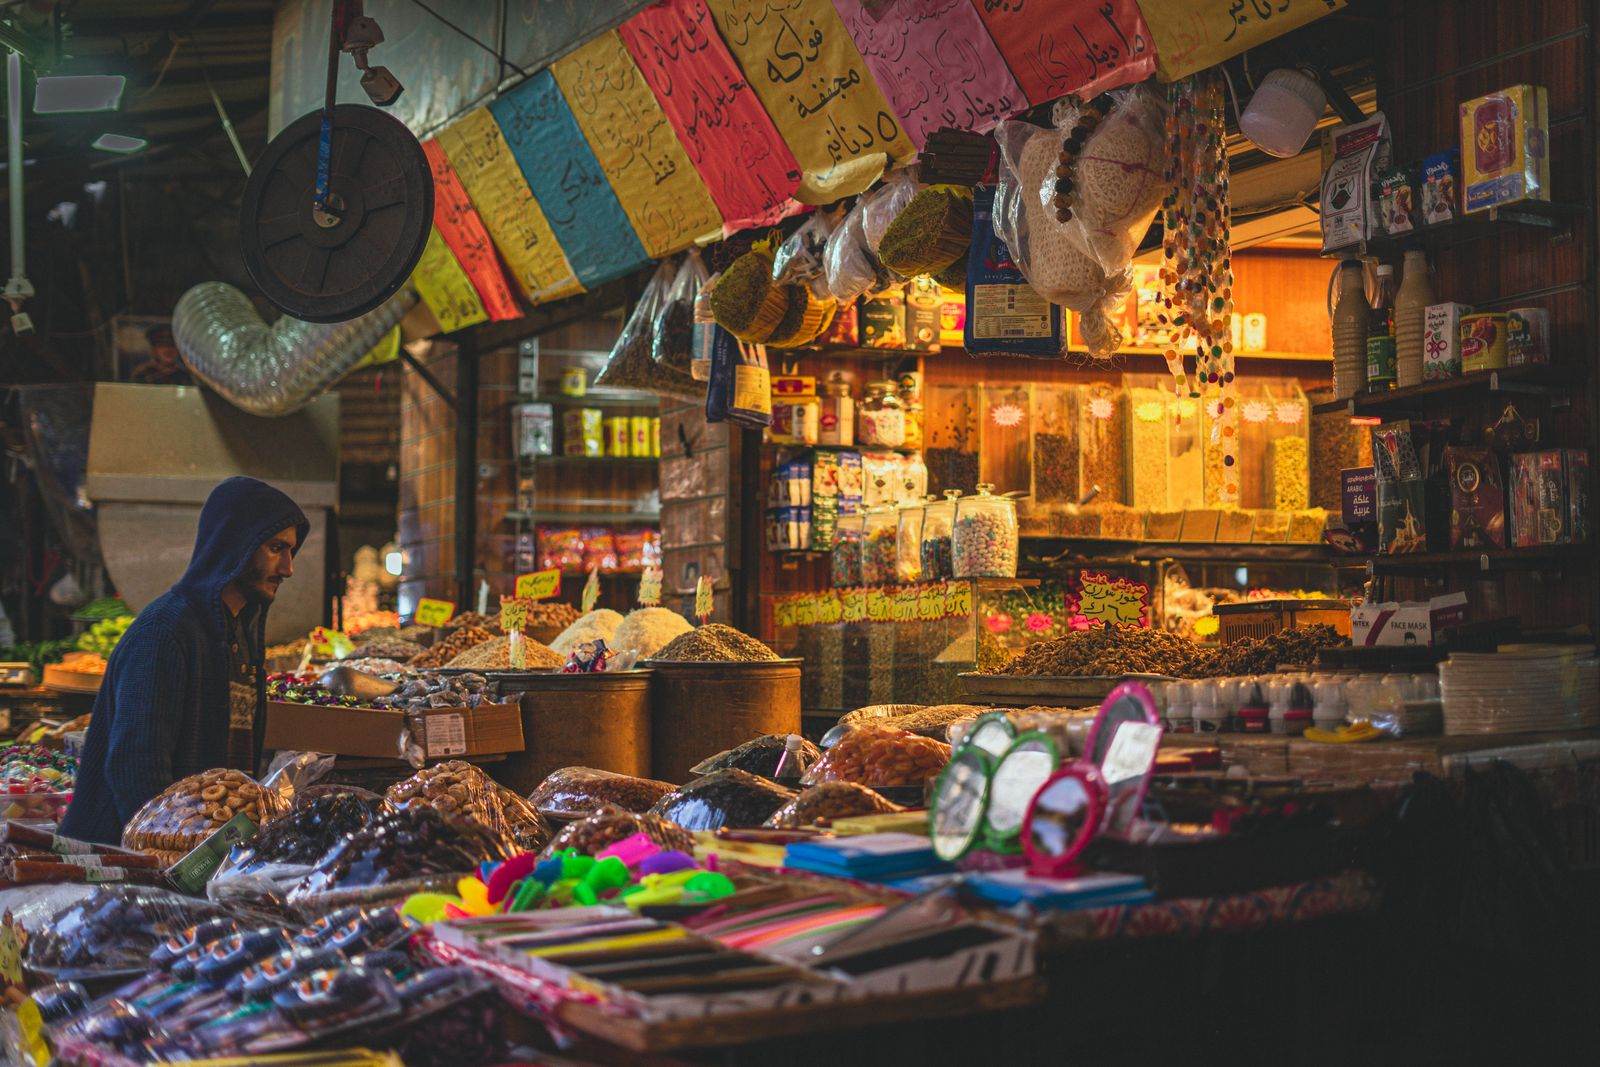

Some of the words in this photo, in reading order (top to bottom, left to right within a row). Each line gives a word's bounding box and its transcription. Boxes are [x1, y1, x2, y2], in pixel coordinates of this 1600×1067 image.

[766, 14, 823, 83] فواكه
[787, 66, 861, 119] مجففة
[876, 110, 899, 142] ٥
[816, 114, 875, 182] دنانير
[1352, 494, 1370, 505] علكة
[1353, 505, 1371, 517] عربية
[1115, 591, 1139, 605] جوز
[1390, 621, 1406, 629] FACE
[1407, 621, 1428, 630] MASK
